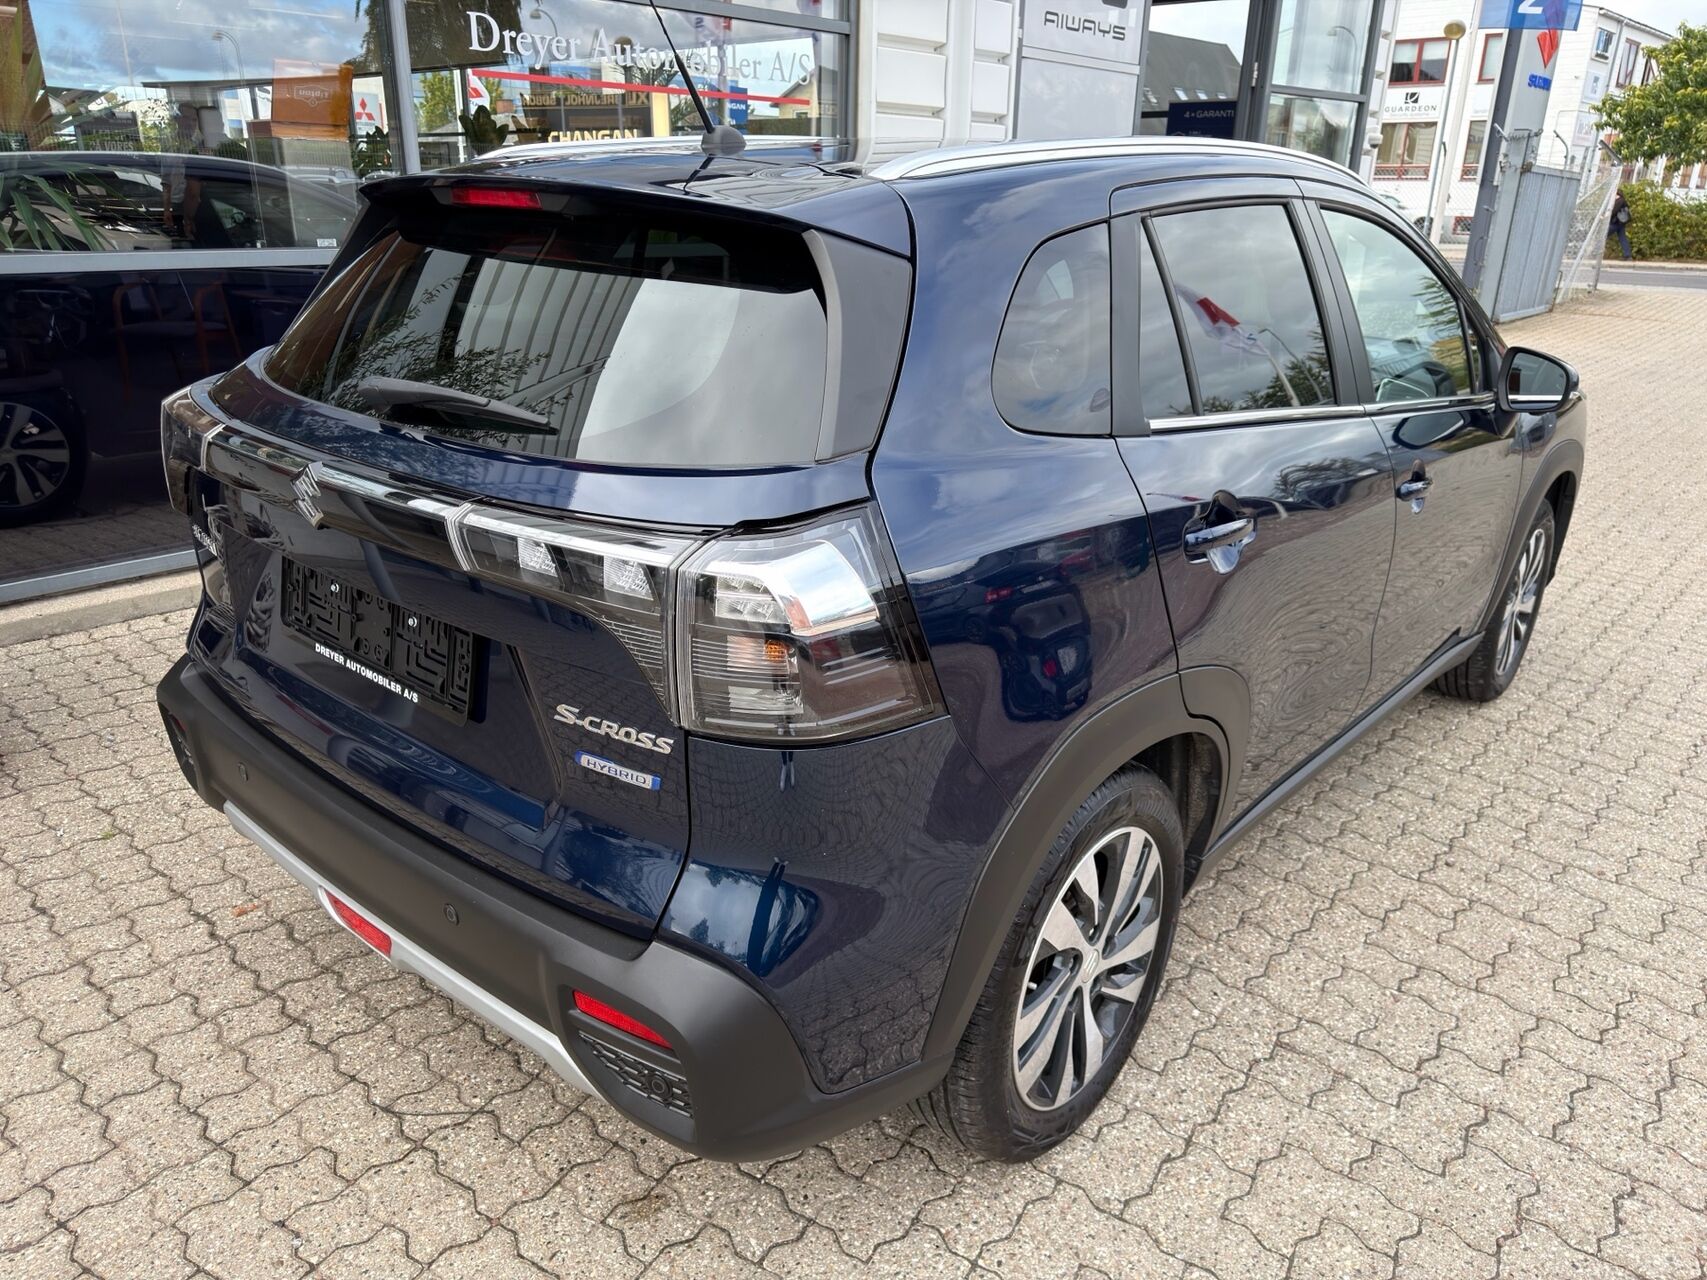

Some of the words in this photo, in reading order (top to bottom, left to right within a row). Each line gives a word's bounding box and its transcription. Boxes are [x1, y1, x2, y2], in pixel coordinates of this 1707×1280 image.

[1044, 11, 1126, 41] AIWAYS
[466, 11, 581, 70] Dreyer
[593, 28, 762, 79] Automobiler
[770, 50, 811, 86] A/S
[1196, 110, 1234, 118] GARANTI
[1384, 105, 1437, 113] GUARDEON
[547, 129, 637, 142] CHANGAN
[315, 642, 344, 666] DREYER
[346, 659, 402, 695] AUTOMOBILER
[403, 688, 418, 703] A/S
[553, 703, 675, 754] S-CROSS
[586, 758, 647, 785] HYBRID
